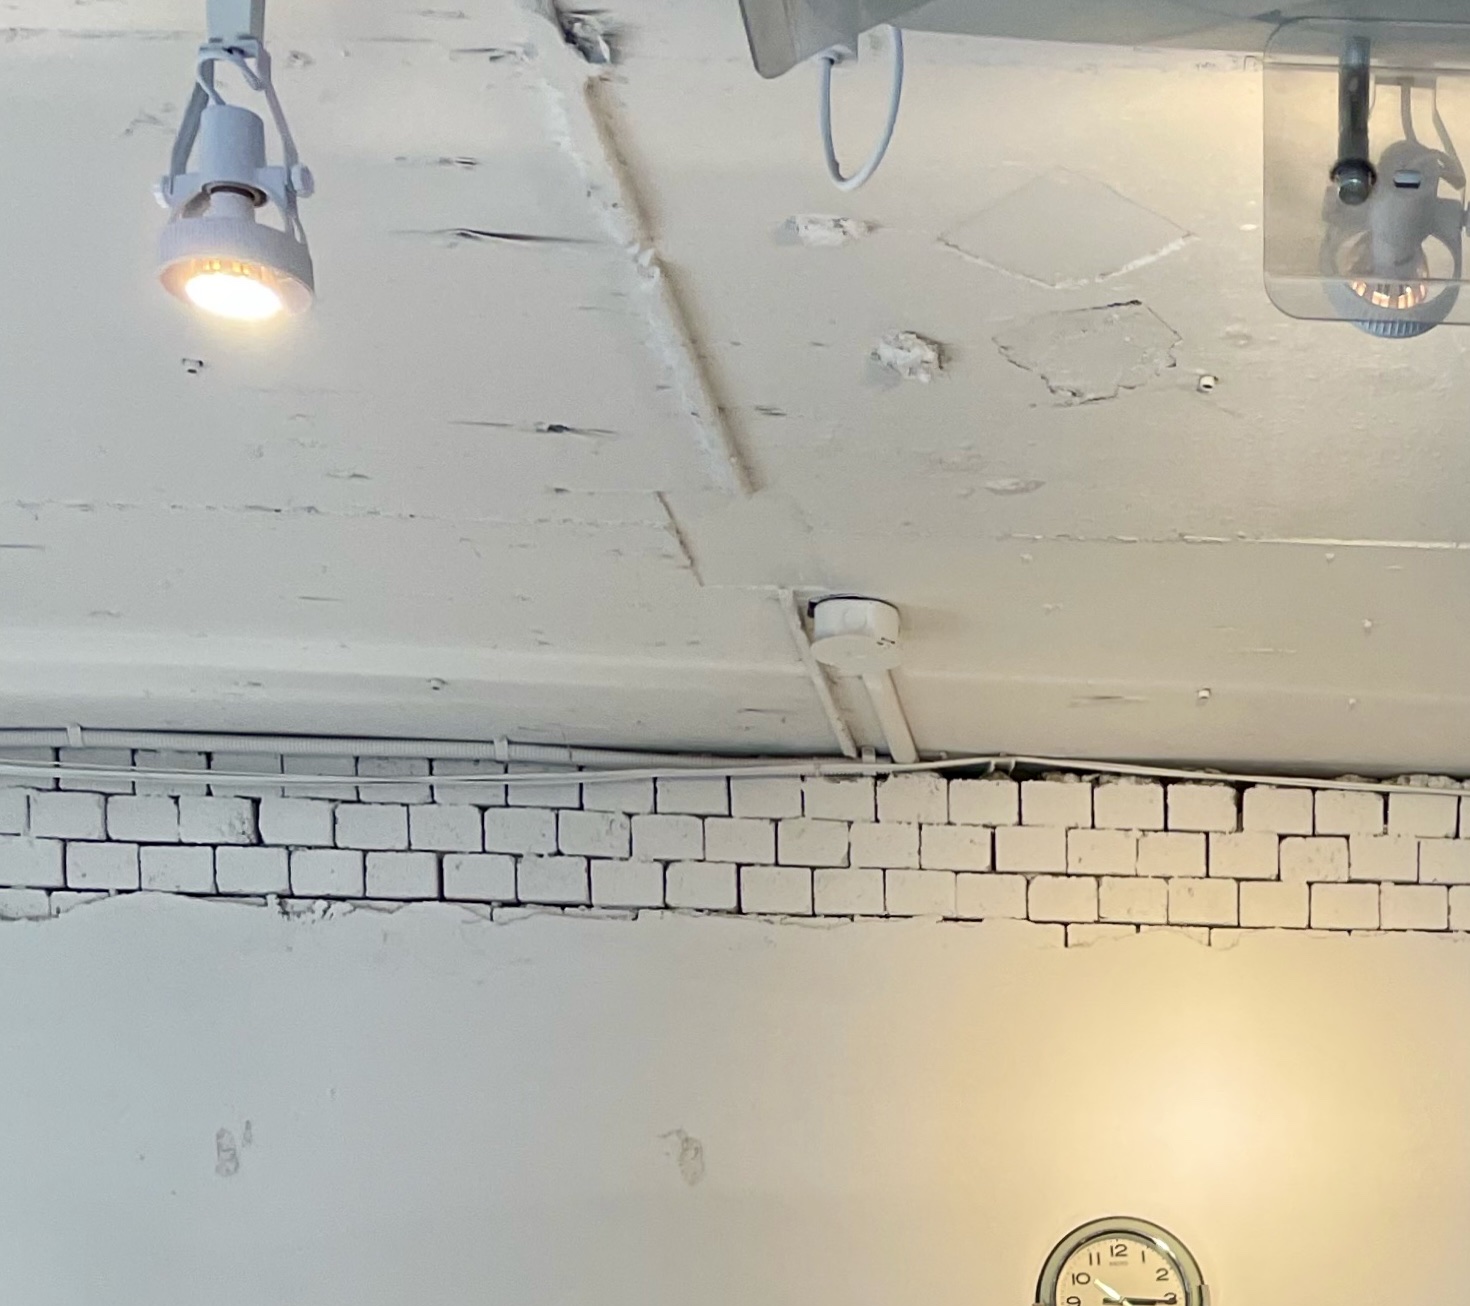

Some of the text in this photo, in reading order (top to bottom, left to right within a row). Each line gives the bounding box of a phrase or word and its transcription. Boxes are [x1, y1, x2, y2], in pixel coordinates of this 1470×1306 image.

[1110, 1244, 1128, 1257] 12
[1141, 1250, 1146, 1264] 1
[1089, 1252, 1101, 1266] 11
[1071, 1272, 1091, 1285] 10
[1156, 1268, 1169, 1282] 2
